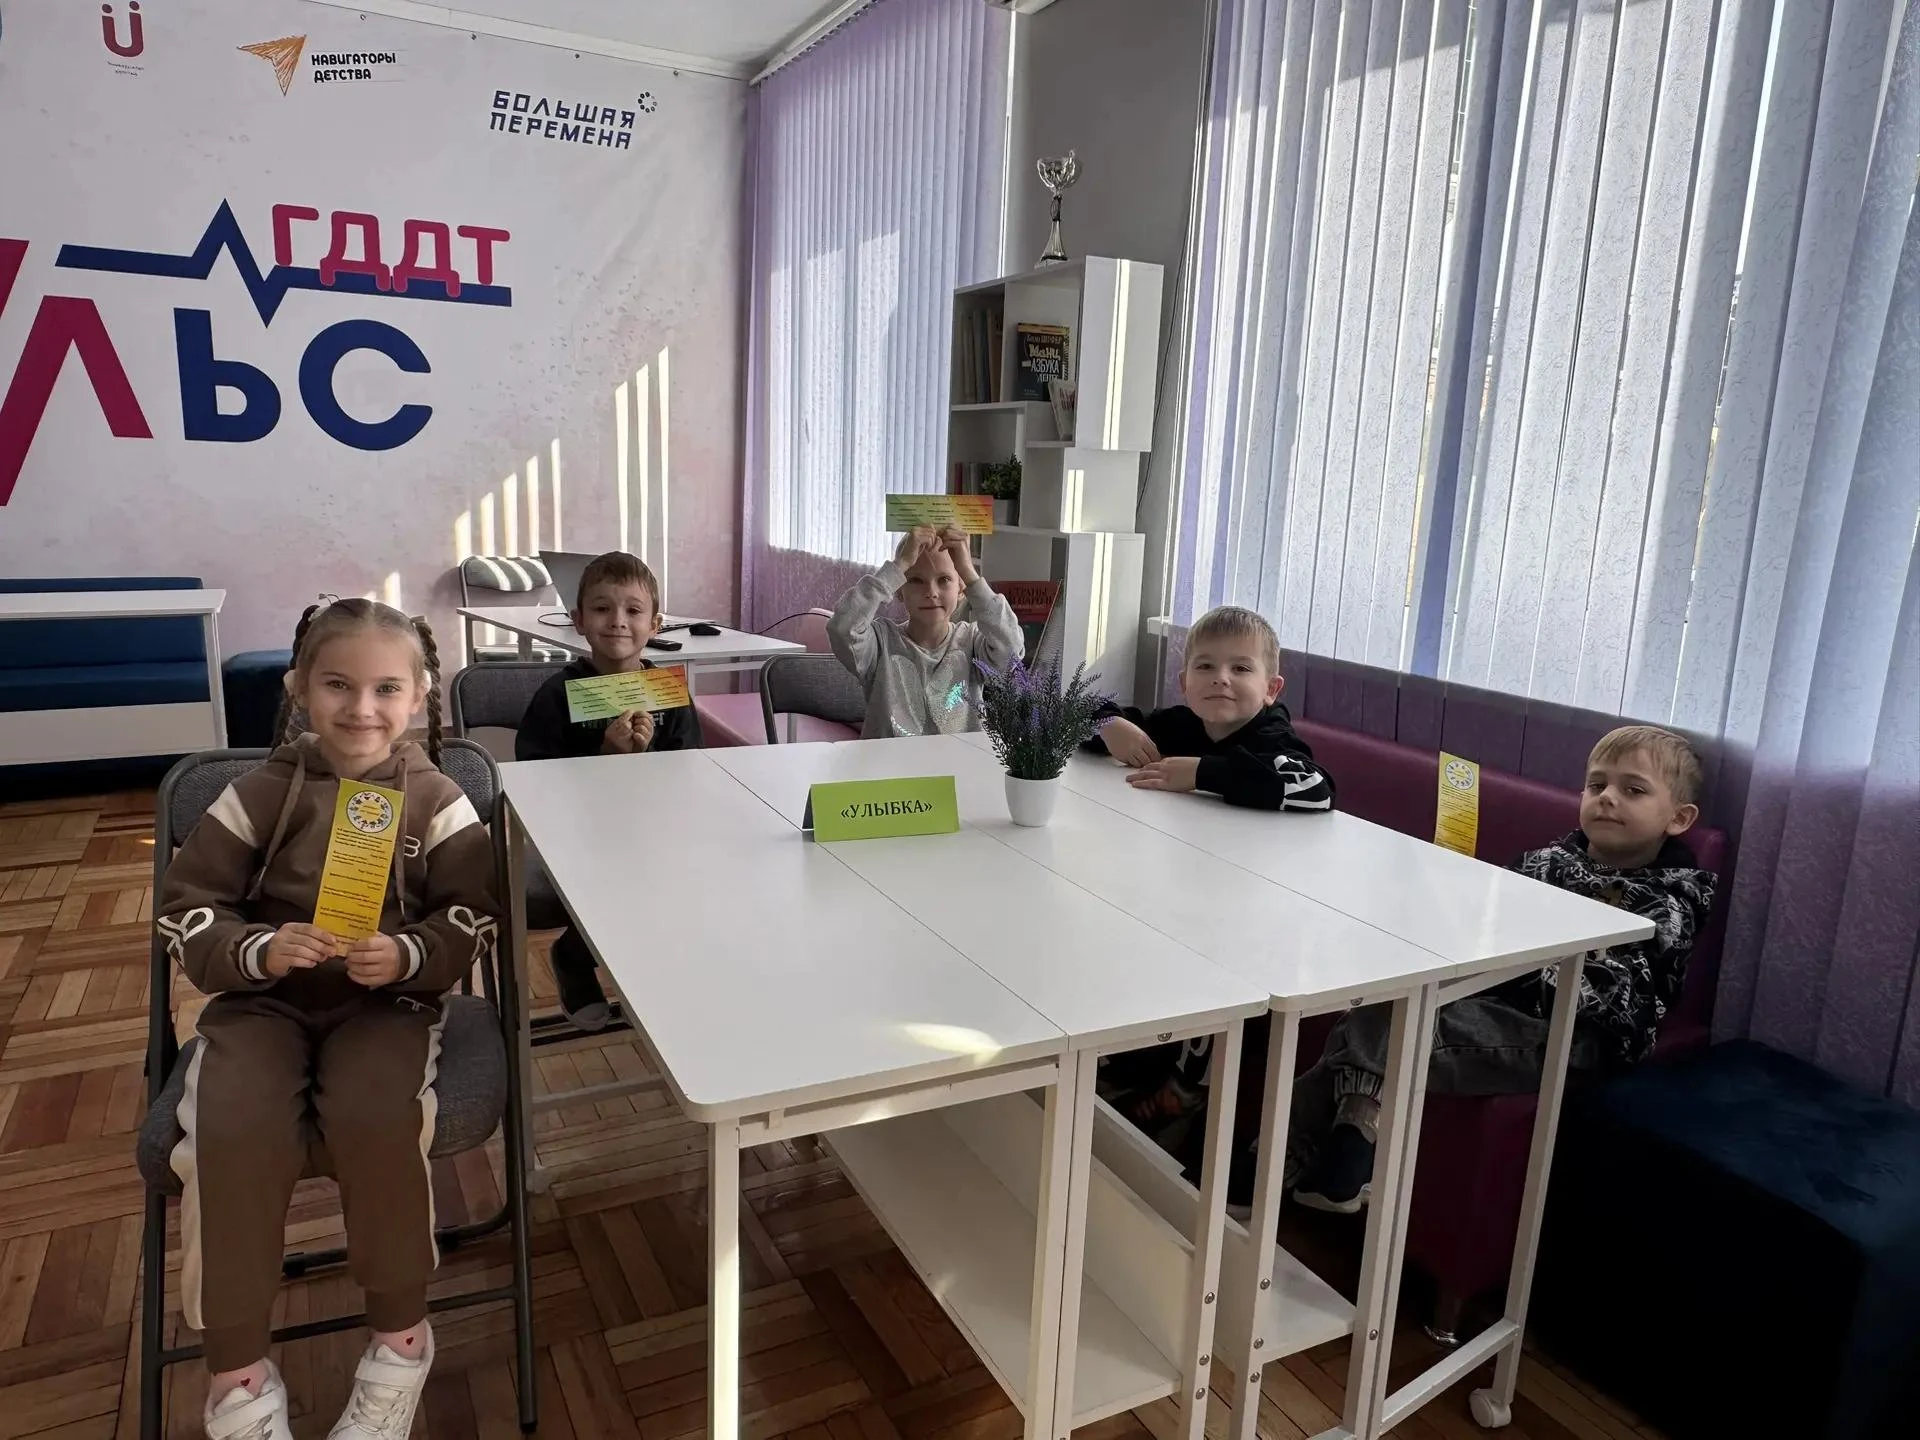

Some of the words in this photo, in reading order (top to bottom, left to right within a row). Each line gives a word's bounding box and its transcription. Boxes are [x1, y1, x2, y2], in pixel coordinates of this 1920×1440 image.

[311, 52, 396, 66] НАВИГАТОРЫ
[313, 68, 372, 83] ДЕТСТВА
[492, 90, 636, 129] БОЛЬШАЯ
[489, 111, 632, 150] ПЕРЕМЕНА
[272, 204, 511, 297] ГДДТ
[0, 238, 433, 503] ЛЬС
[1030, 358, 1060, 374] АЗБУКА
[840, 799, 934, 819] «УЛЫБКА»
